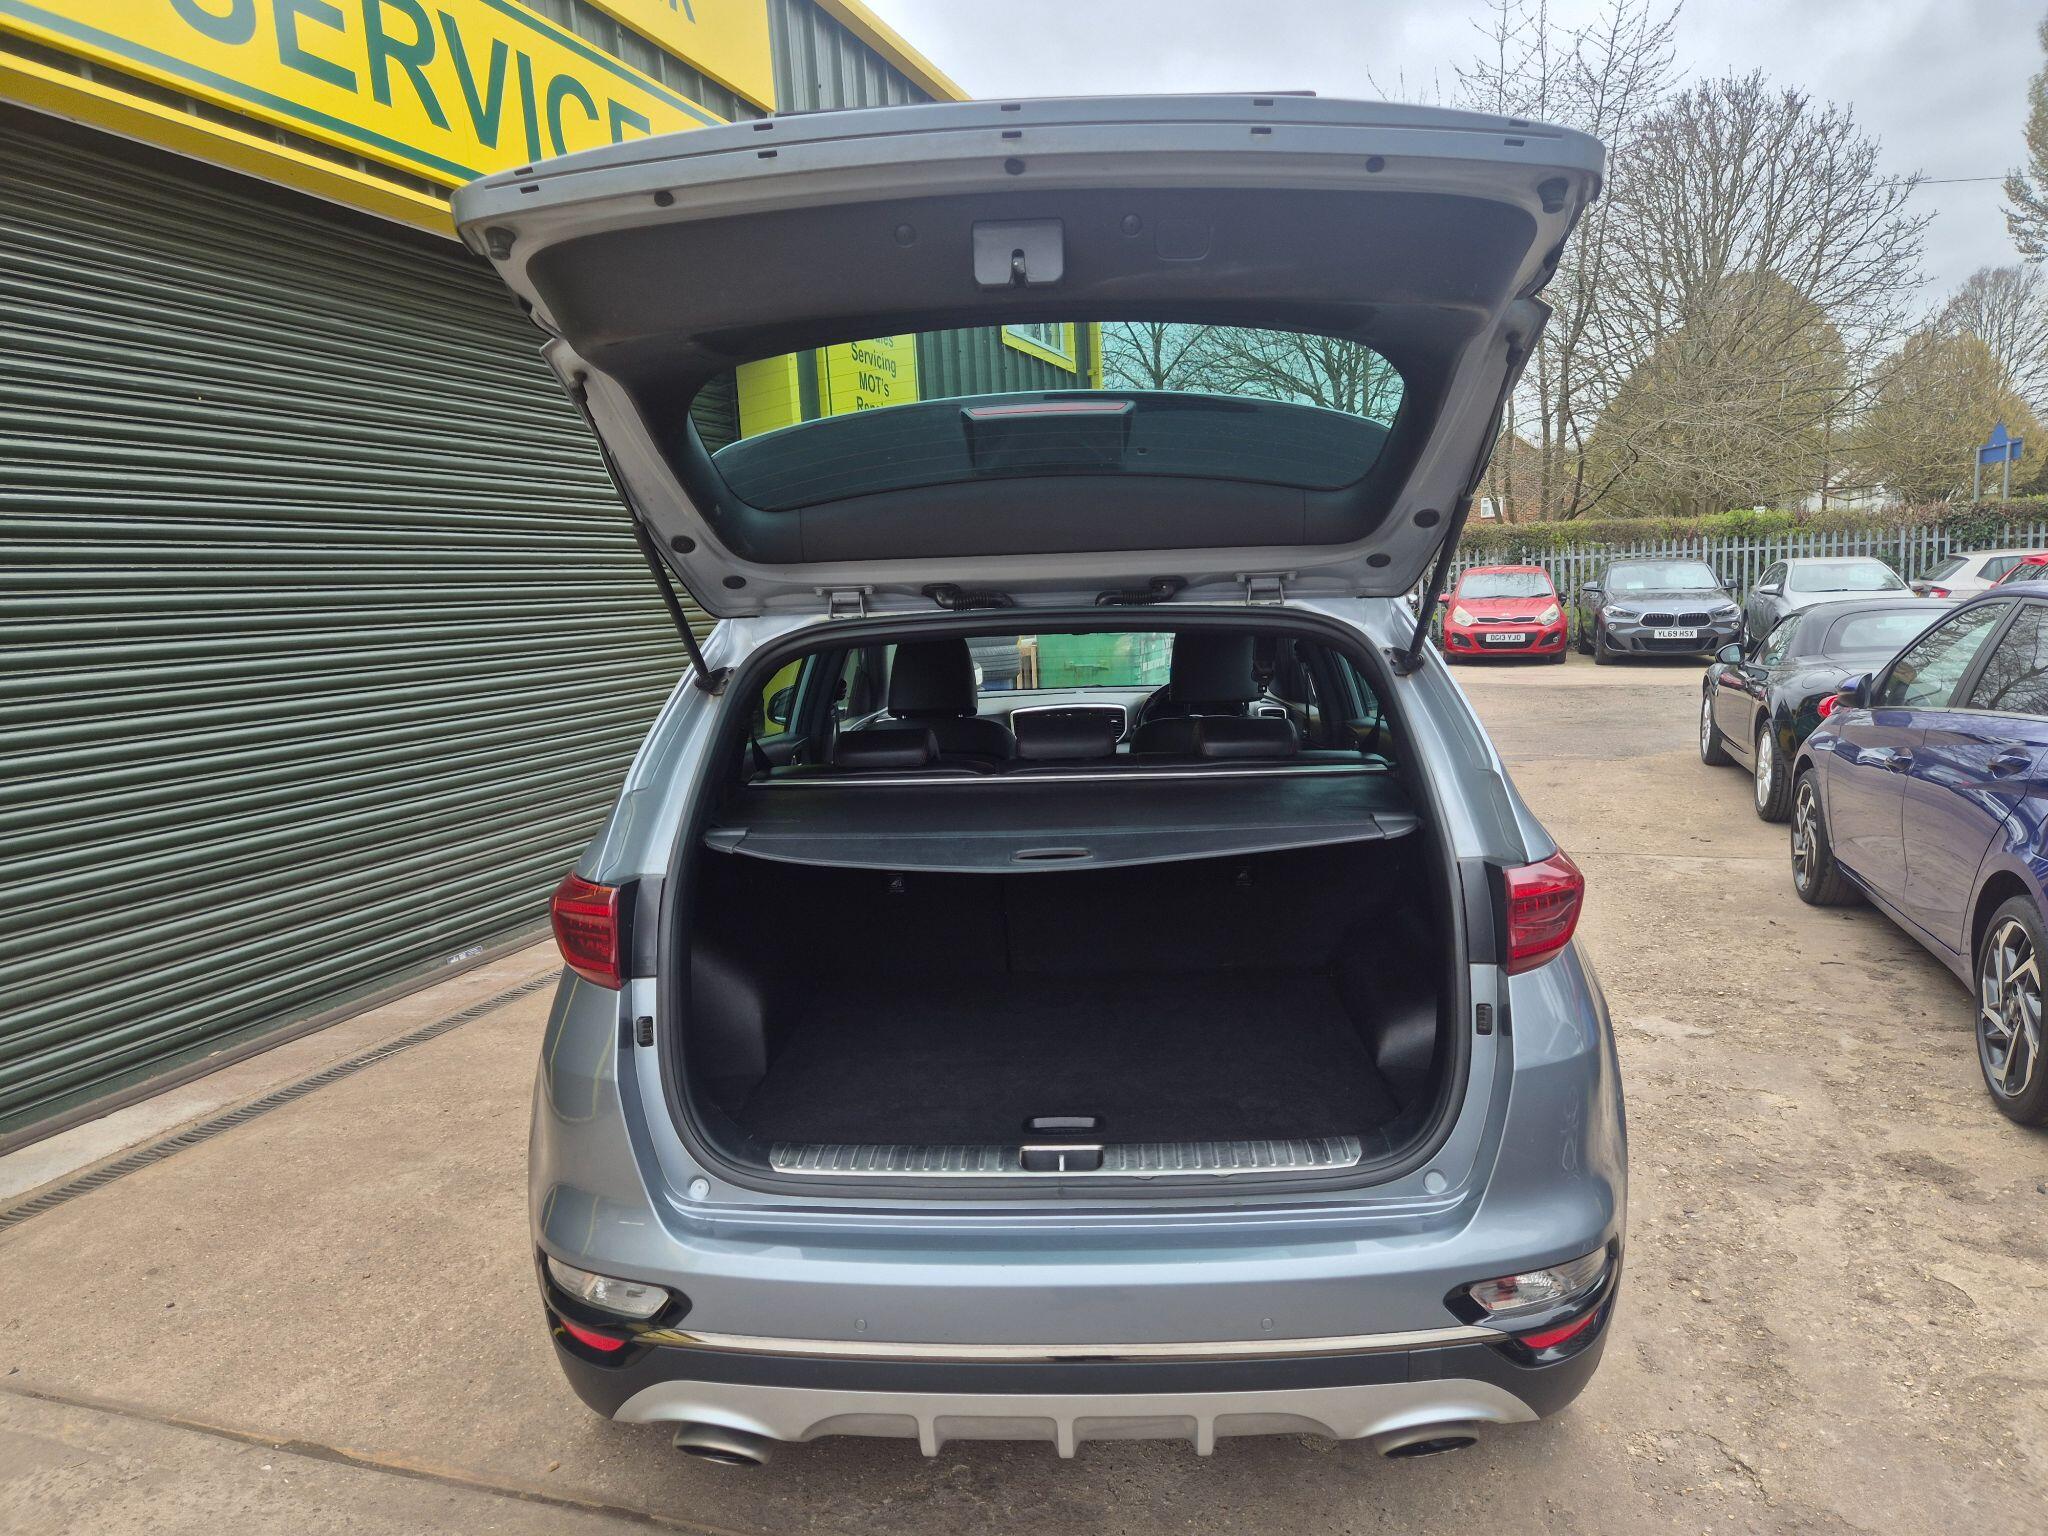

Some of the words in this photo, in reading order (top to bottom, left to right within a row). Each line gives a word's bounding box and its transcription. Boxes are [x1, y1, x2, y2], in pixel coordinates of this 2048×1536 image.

[168, 0, 651, 163] ERVIC
[851, 342, 896, 378] Servicing
[859, 371, 889, 397] MOT's
